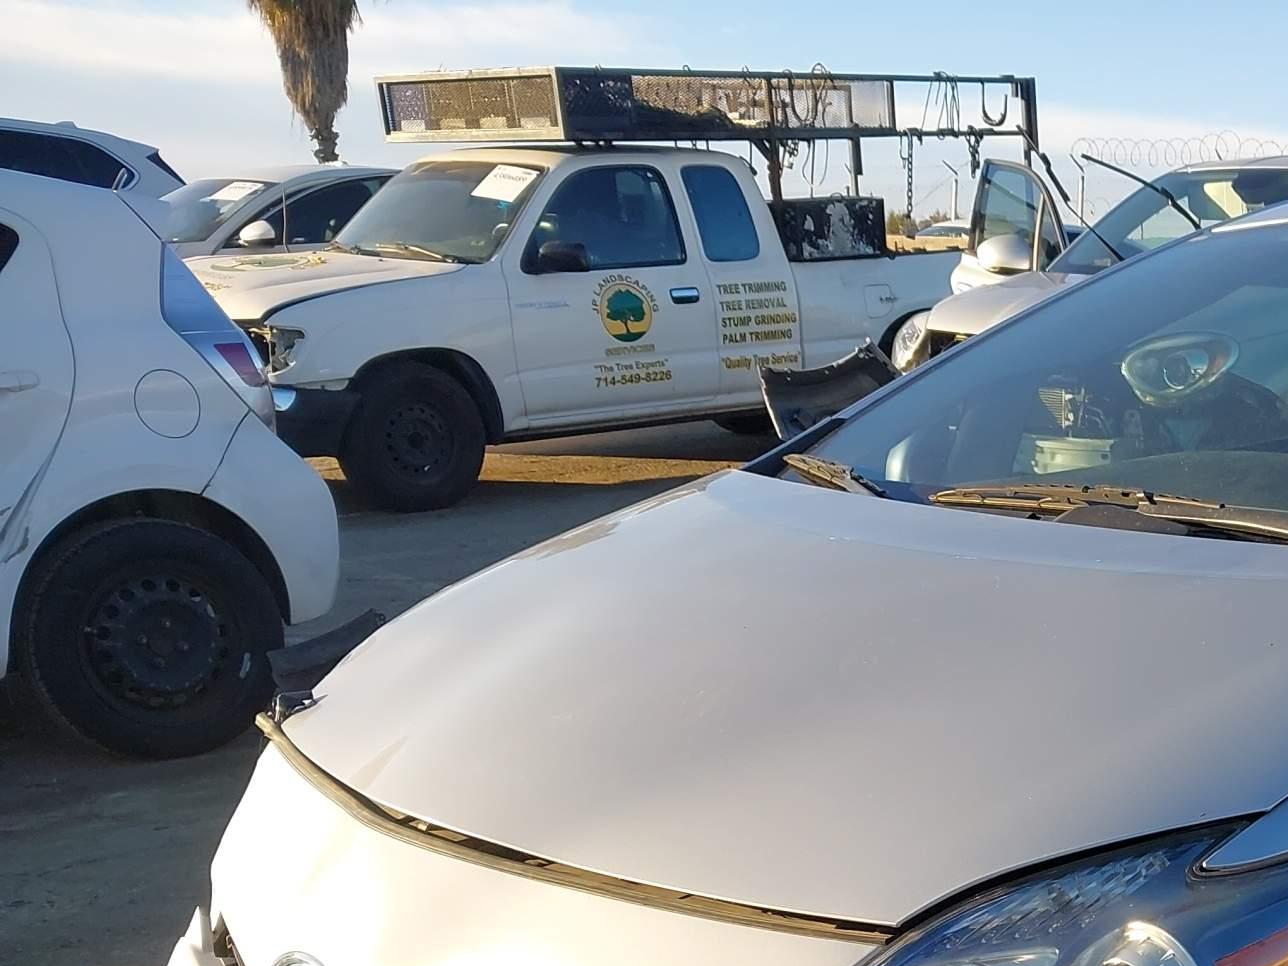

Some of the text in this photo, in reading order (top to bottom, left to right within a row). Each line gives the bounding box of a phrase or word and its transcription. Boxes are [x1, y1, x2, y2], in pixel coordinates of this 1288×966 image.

[593, 273, 660, 313] LANDSCAPING
[716, 281, 788, 296] TREE TRIMMING
[720, 296, 788, 313] TREE REMOVAL
[721, 312, 798, 329] STUMP GRINDING
[722, 328, 793, 345] PALM TRIMMING
[615, 362, 635, 372] Tree
[594, 369, 673, 388] 714-549-8226
